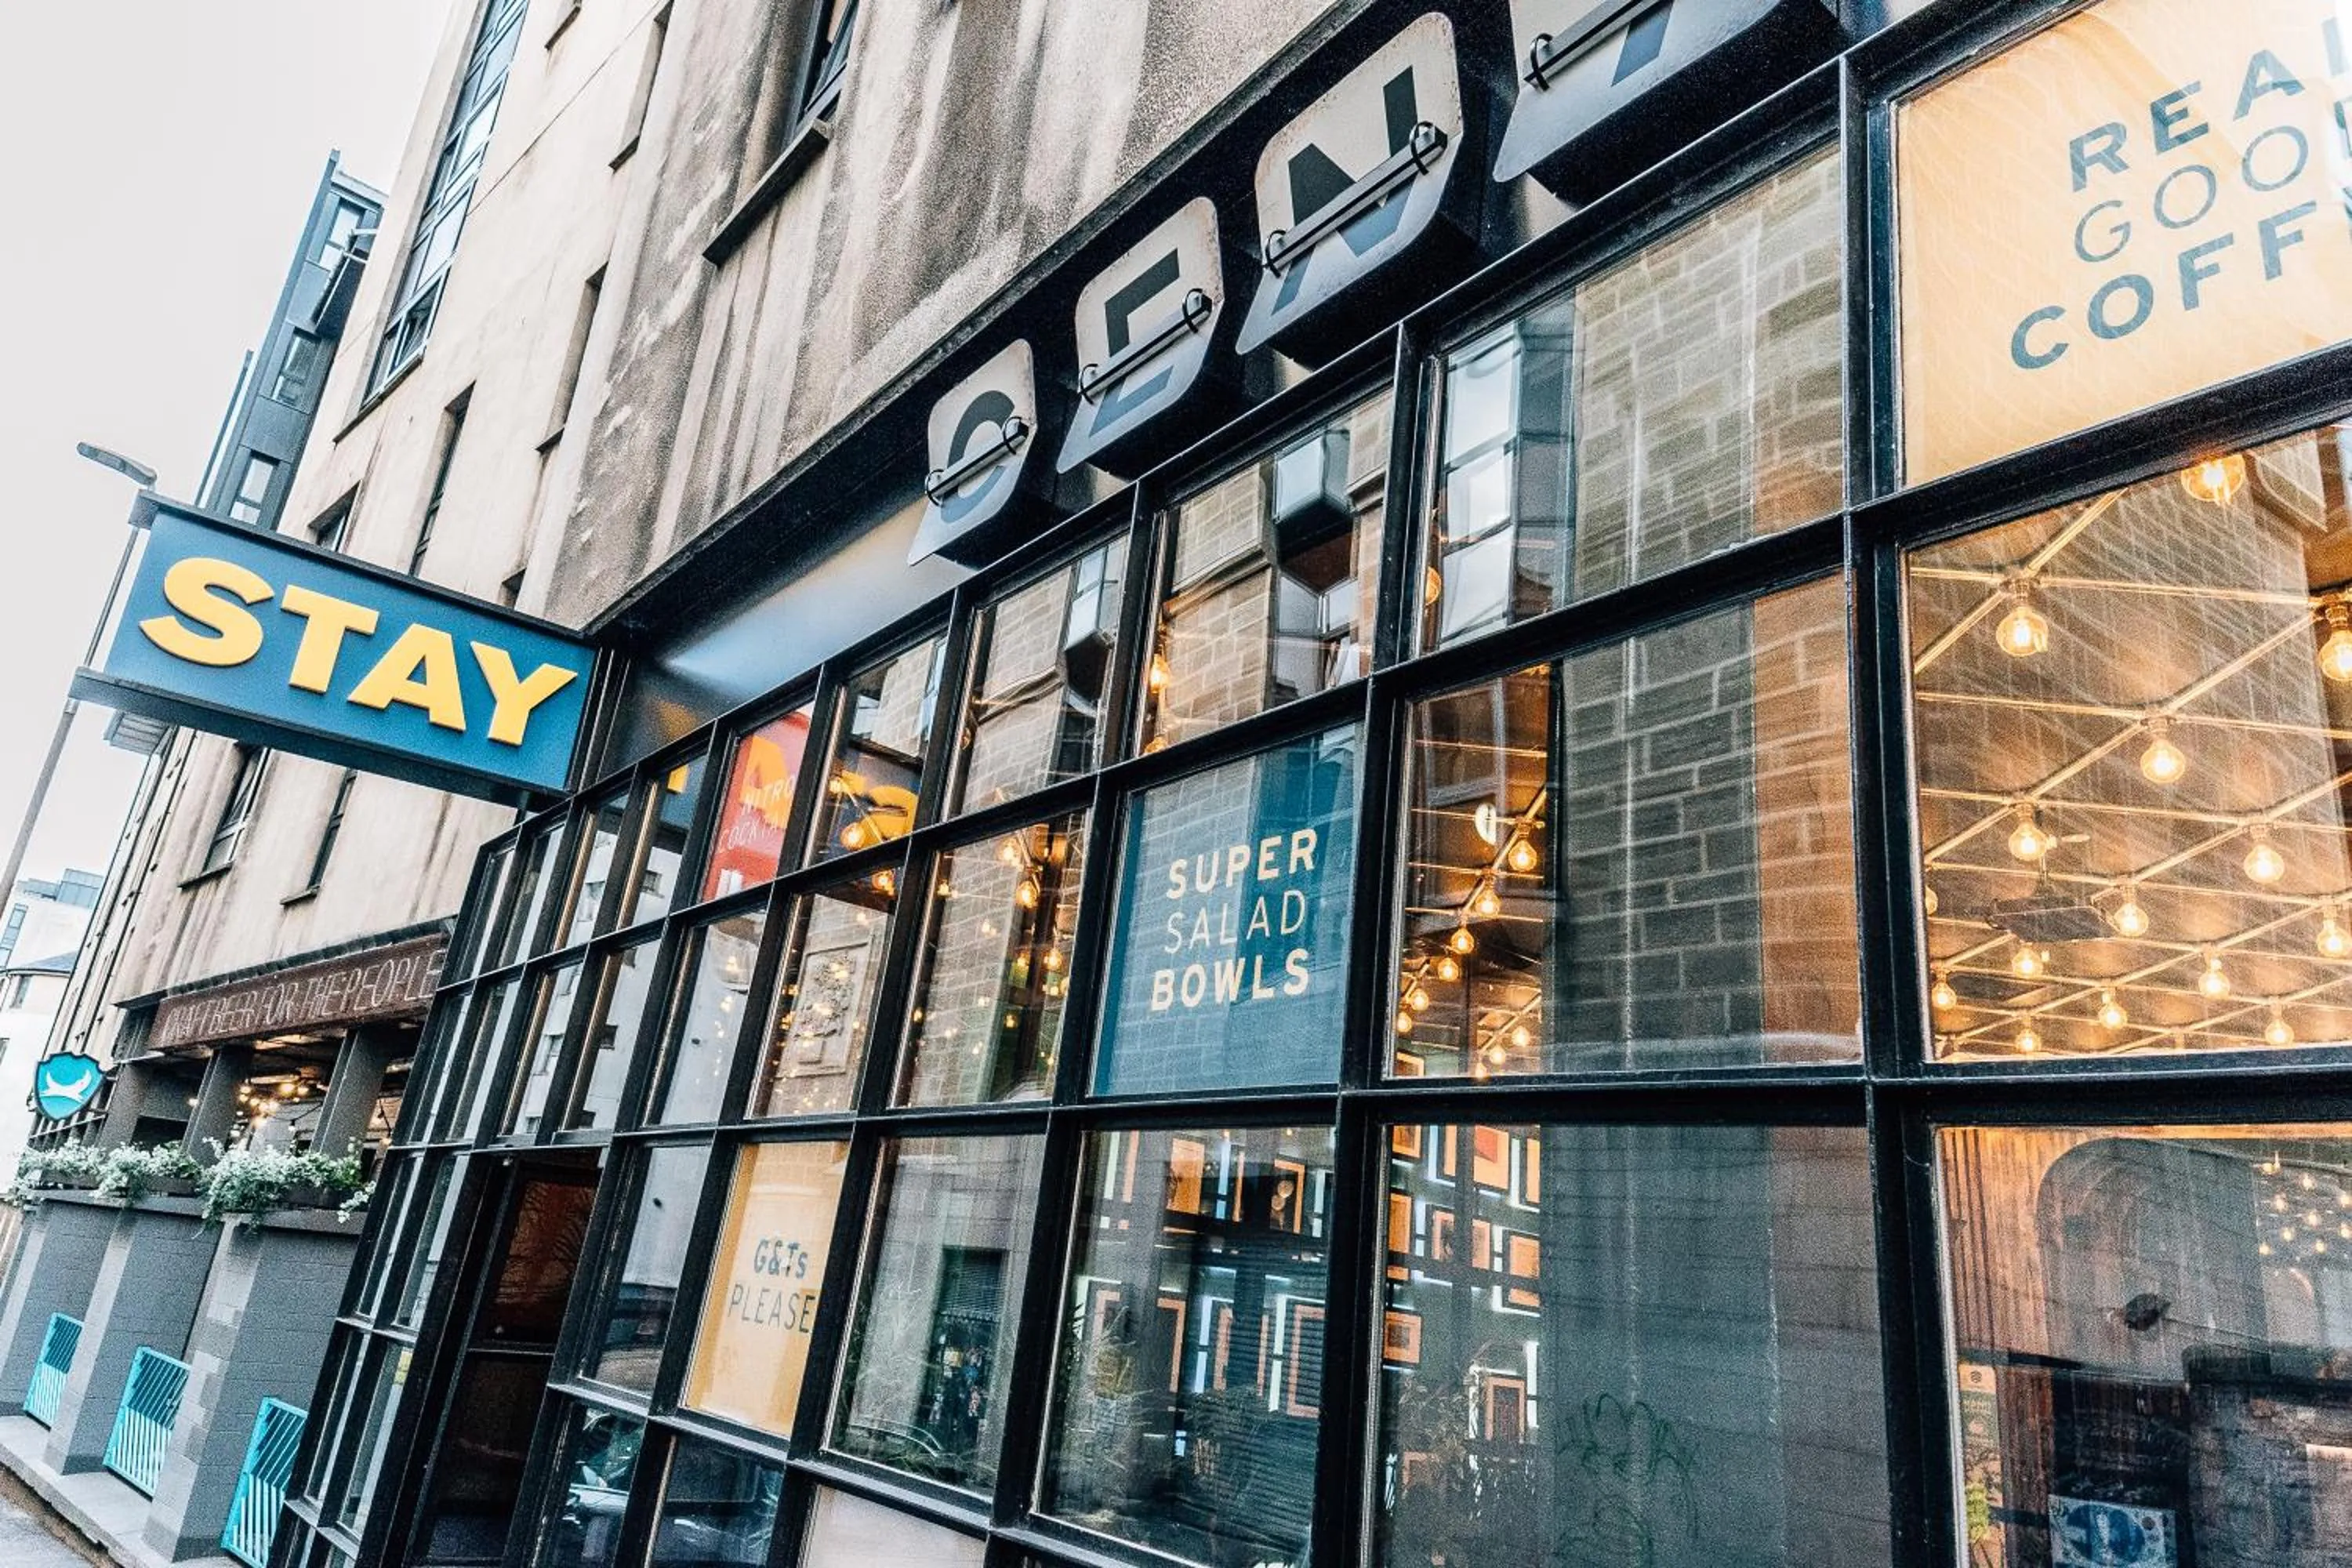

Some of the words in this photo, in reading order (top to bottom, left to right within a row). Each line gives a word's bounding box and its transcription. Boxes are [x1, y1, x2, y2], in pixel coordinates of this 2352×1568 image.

[2074, 96, 2352, 263] GOO
[139, 557, 579, 747] STAY
[1165, 828, 1318, 900] SUPER
[1164, 889, 1306, 954] SALAD
[208, 990, 260, 1036] BEER
[256, 982, 299, 1026] FOR
[299, 971, 347, 1019] THE
[339, 948, 449, 1013] PEOPLE
[1150, 948, 1309, 1011] BOWLS
[753, 1238, 809, 1280] G&Ts
[727, 1283, 817, 1334] PLEASE
